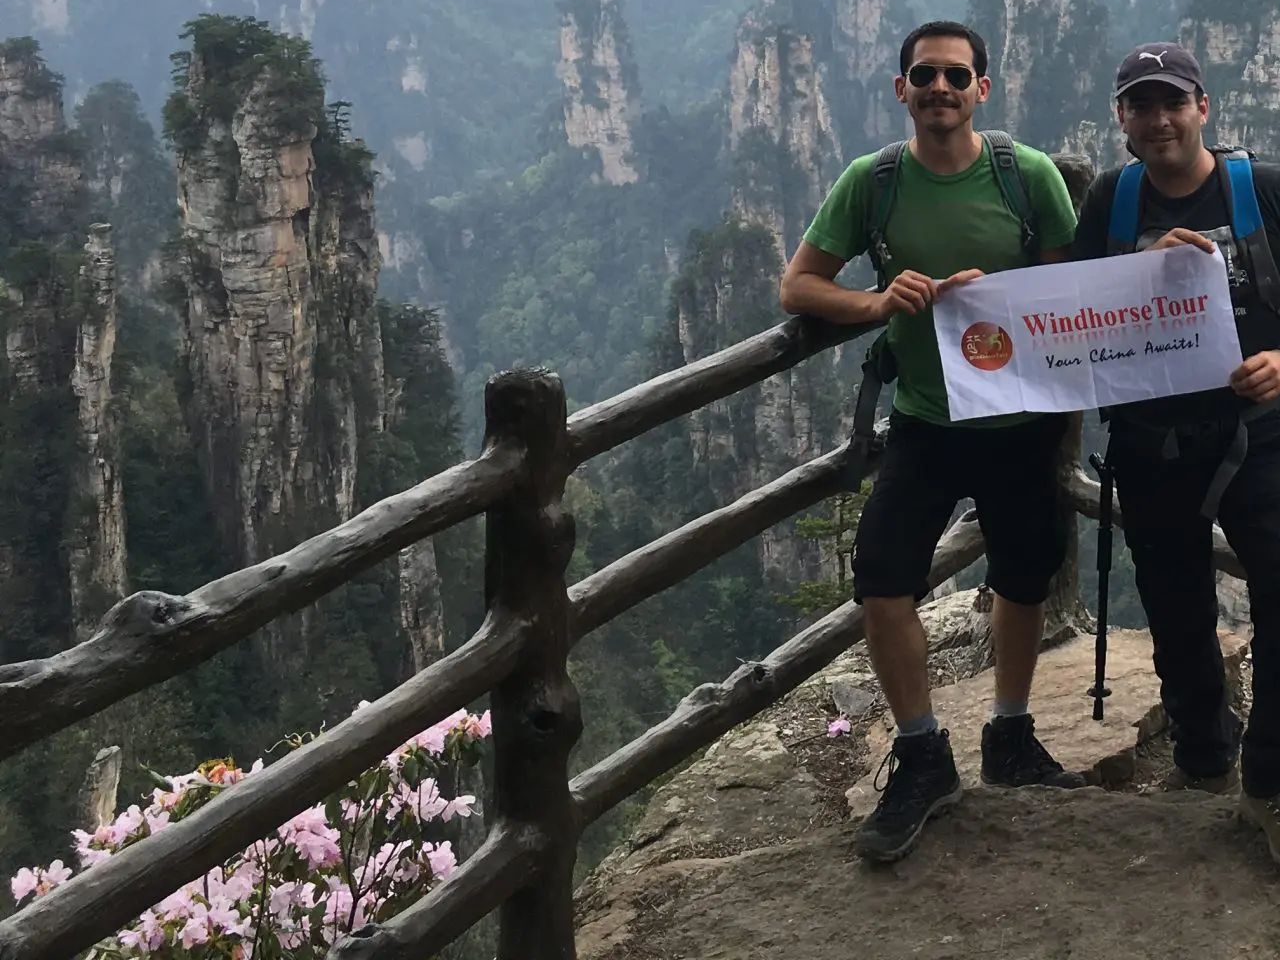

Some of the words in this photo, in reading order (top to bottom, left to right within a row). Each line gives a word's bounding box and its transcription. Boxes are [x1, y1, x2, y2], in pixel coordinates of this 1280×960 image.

[1022, 294, 1209, 337] WindhorseTour
[1045, 355, 1082, 369] Your
[1089, 347, 1136, 363] China
[1143, 333, 1200, 355] Awaits!
